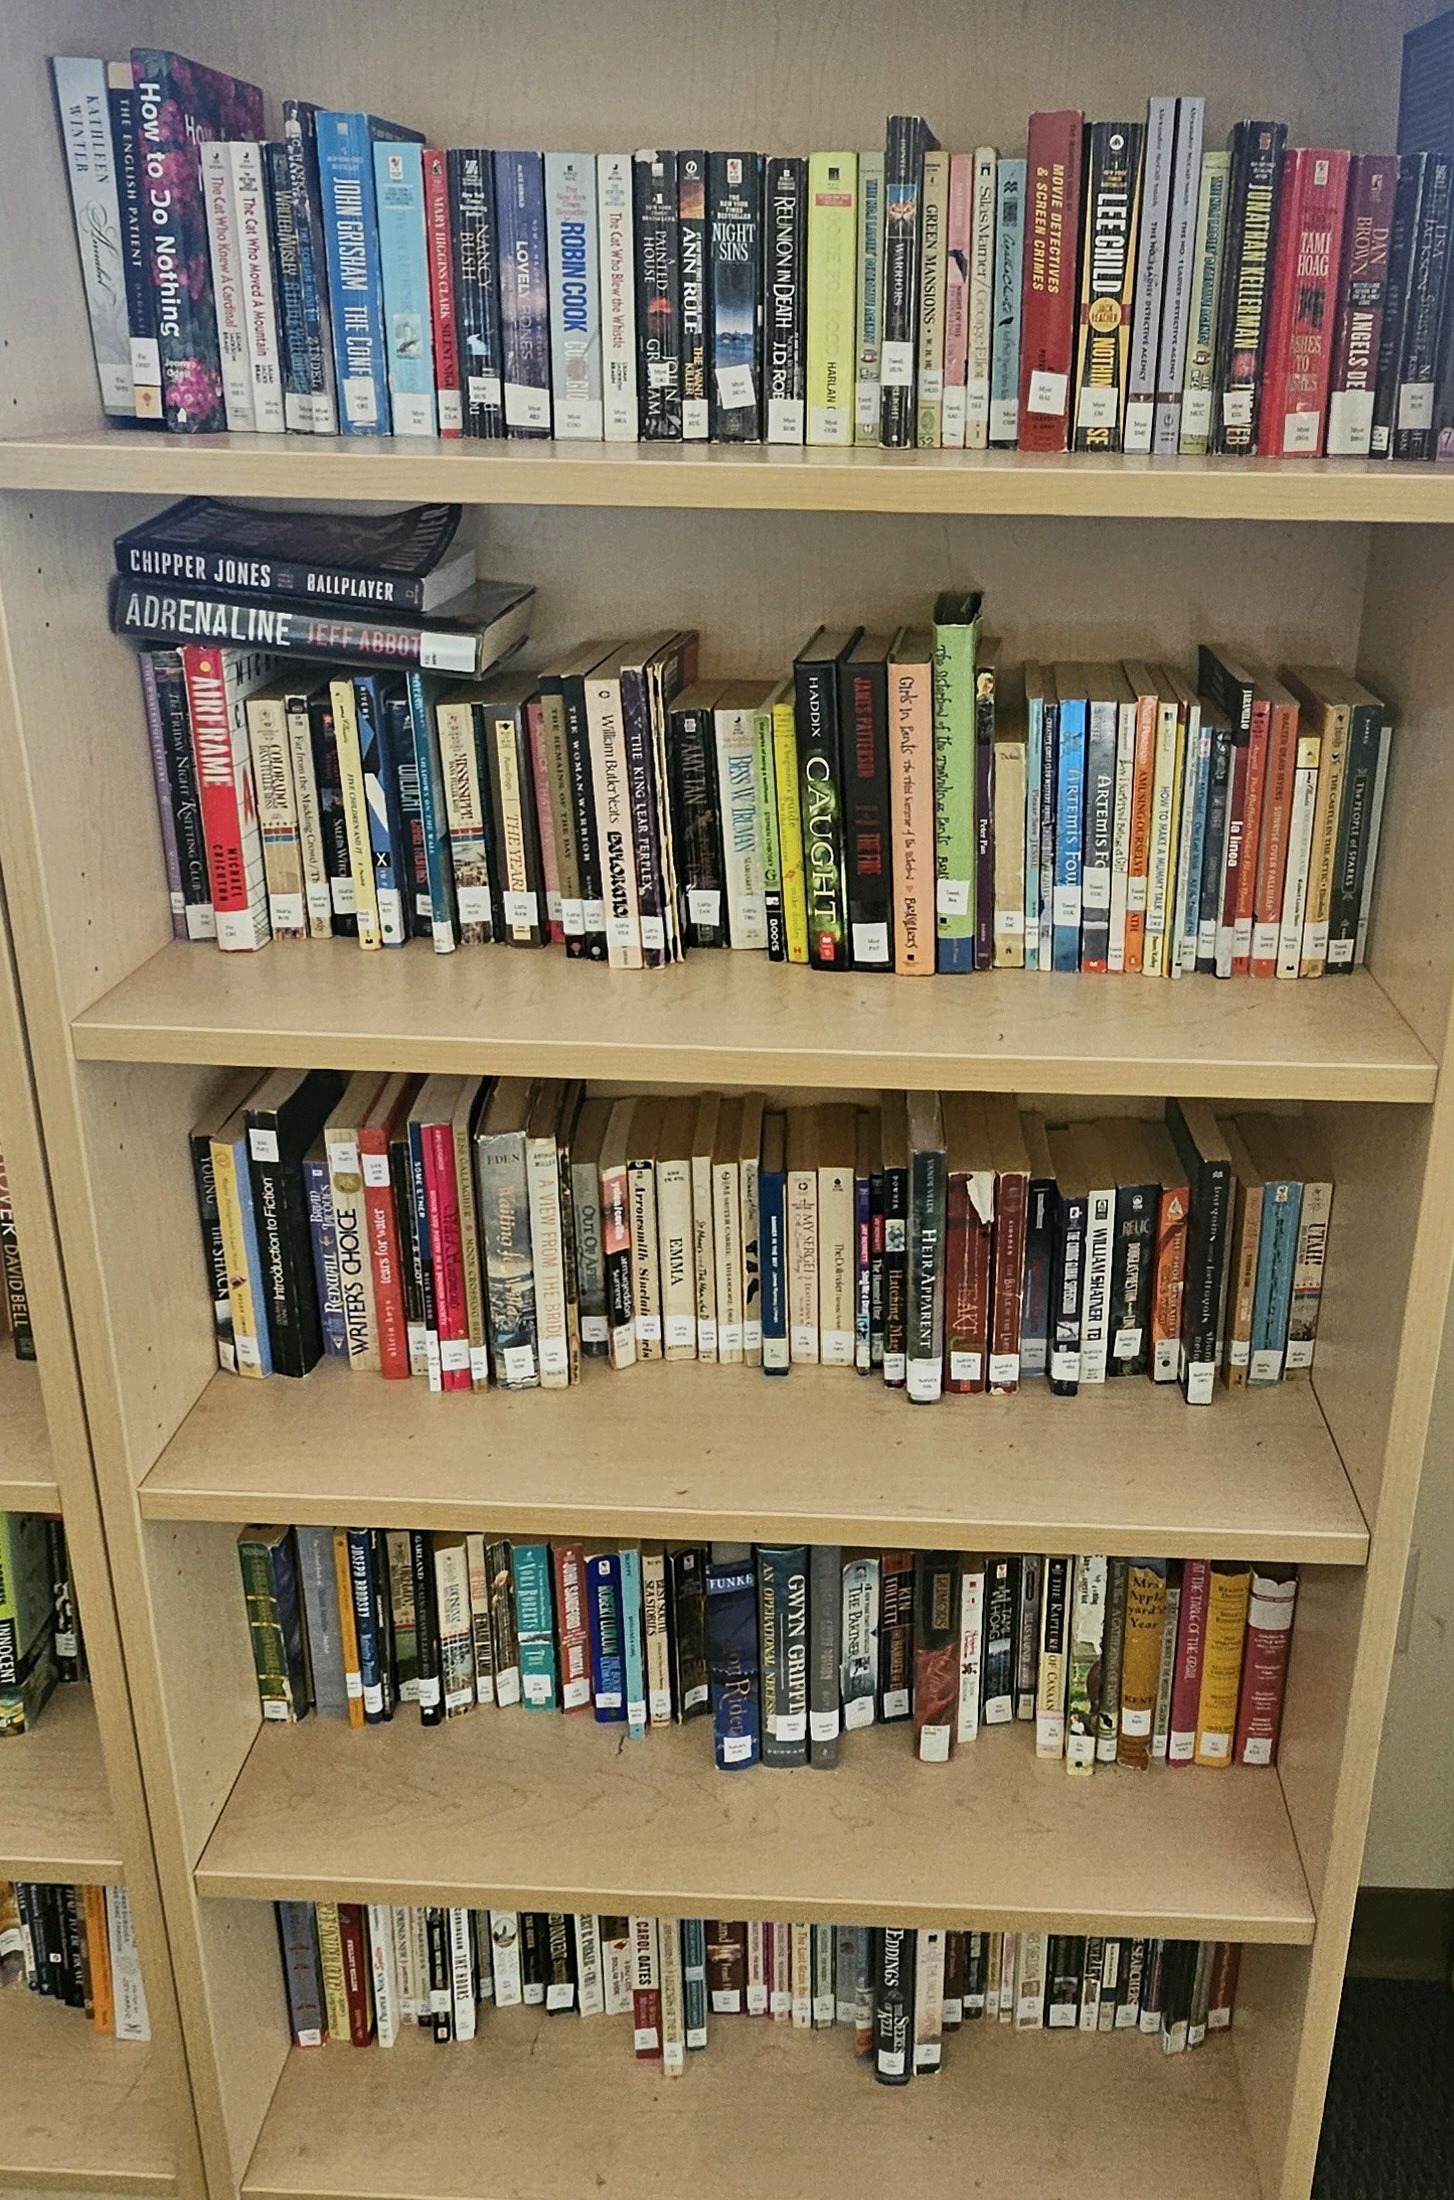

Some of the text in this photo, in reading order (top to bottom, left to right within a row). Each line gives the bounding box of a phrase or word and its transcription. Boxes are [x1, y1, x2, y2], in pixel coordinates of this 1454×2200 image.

[70, 104, 90, 173] WINTER
[85, 95, 110, 184] KATHLEEN
[138, 83, 161, 142] How
[120, 99, 142, 267] THE ENGLISH PATIENT
[146, 153, 164, 179] to
[211, 177, 224, 194] The
[1051, 164, 1065, 208] MOVIE
[213, 197, 226, 215] Cat
[217, 220, 230, 242] Who
[334, 177, 368, 290] JOHN GRISHAM
[712, 223, 757, 243] NIGHT
[1032, 167, 1048, 290] & SCREEN CRIMES
[1096, 193, 1128, 230] LEE
[220, 243, 232, 273] Knew
[434, 197, 451, 318] MARY HIGGINS CLARK
[461, 232, 475, 280] BUSH
[476, 225, 492, 290] NANCY
[644, 236, 656, 283] HOUSE
[720, 243, 749, 262] SINS
[773, 196, 796, 328] REUNION IN DEATH
[923, 204, 939, 324] GREEN MANSIONS
[1047, 213, 1063, 293] DETECTIVES
[1092, 235, 1125, 292] CHILD
[1234, 183, 1272, 349] JONATHAN KELLERMAN
[1297, 254, 1328, 277] HOAG
[1300, 233, 1329, 254] TAMI
[1353, 217, 1373, 275] BROWN
[1371, 227, 1389, 265] DAN
[154, 236, 181, 337] Nothing
[222, 275, 232, 284] A
[223, 286, 237, 327] Cardinal
[243, 198, 269, 356] The Cat Who Moved A Mountain
[561, 222, 587, 332] ROBIN COOK
[610, 213, 625, 349] The Cat Who Blew the Whistle
[683, 227, 698, 334] ANN RULE
[344, 305, 368, 331] THE
[1347, 312, 1373, 366] ANGELS
[826, 362, 837, 403] HARLAN
[130, 549, 394, 602] CHIPPER JONES BALLPLAYER
[125, 594, 352, 649] ADRENALINE JEFF
[190, 675, 234, 787] AIRFRAME
[809, 677, 821, 738] HADDIX
[853, 677, 874, 778] JAMES PATTERSON
[170, 711, 201, 891] FRIDAY NIGHT KNITTING CLUB
[293, 735, 320, 864] Far from the Madding Crowd
[681, 744, 705, 805] AMY TAN
[729, 754, 756, 853] BESS TRUMAN
[1136, 769, 1149, 814] AMUSING
[1160, 786, 1169, 808] HOW
[506, 814, 520, 845] THE
[631, 733, 653, 891] THE KING LEAR PERPLEX
[807, 757, 837, 924] CAUGHT
[978, 819, 989, 855] Peter Pan
[1157, 824, 1168, 845] MAKE
[1159, 810, 1169, 820] TO
[227, 848, 243, 898] MICHAEL
[1154, 892, 1164, 911] TALK
[1155, 856, 1166, 890] MUMMY
[201, 1155, 215, 1205] YOUNG
[414, 1161, 426, 1218] SOME ETHER
[458, 1158, 473, 1217] GALLAGHER
[211, 1226, 230, 1299] THE SHACK
[263, 1178, 286, 1300] Introduction to Fiction
[539, 1180, 559, 1300] A VIEW FROM THE
[669, 1238, 684, 1286] EMMA
[802, 1213, 816, 1273] MY SERGEI
[1305, 1223, 1326, 1266] UTAH!
[3, 1243, 28, 1327] DAVID BELL
[337, 1209, 369, 1357] WRITER'S CHOICE
[465, 1238, 481, 1317] NOON CROSSING
[613, 1269, 624, 1309] summer
[620, 1255, 633, 1317] armageddon
[920, 1228, 937, 1349] HEIR APPARENT
[1088, 1228, 1108, 1321] WILLIAM SHATNER
[414, 1536, 425, 1580] GARLAND
[598, 1585, 618, 1654] ROBERT LUDLUM
[645, 1580, 658, 1636] SEA STORIES
[762, 1563, 775, 1667] AN OPERATIONAL
[787, 1575, 806, 1636] GWYN
[848, 1585, 863, 1660] THE PARTNER
[884, 1577, 898, 1626] FOLLETT
[898, 1587, 912, 1610] KEN
[989, 1606, 1000, 1639] HOAG
[1046, 1578, 1063, 1711] THE RAPTURE OF CANAAN
[455, 1954, 469, 2000] THE HOURS
[637, 1921, 651, 1986] CAROL OATES
[884, 1927, 905, 1987] EDDINGS
